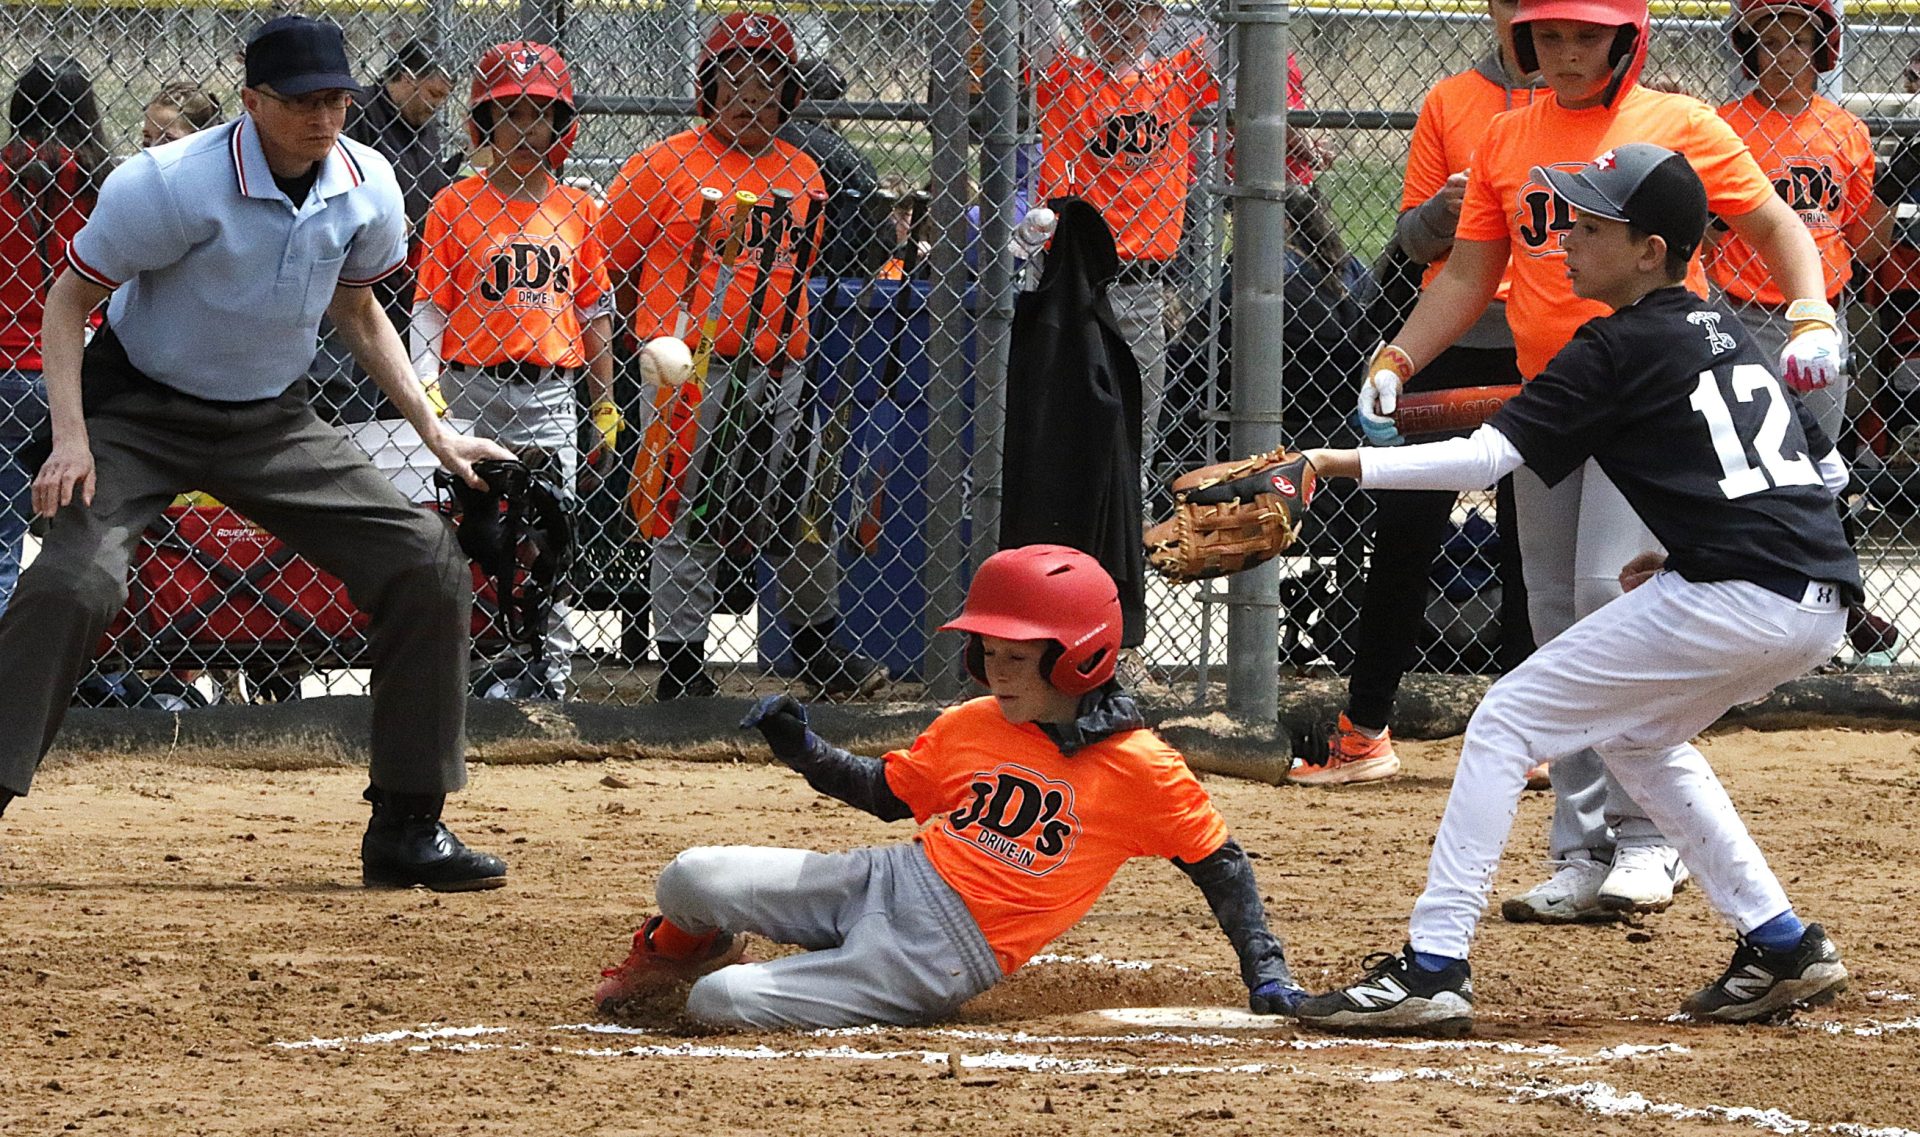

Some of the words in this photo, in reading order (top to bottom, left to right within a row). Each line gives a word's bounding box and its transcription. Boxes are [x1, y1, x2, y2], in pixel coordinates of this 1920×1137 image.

[480, 243, 570, 301] JD's
[1689, 363, 1825, 500] 12
[949, 773, 1072, 857] JD's
[977, 829, 1036, 867] DRIVE-IN
